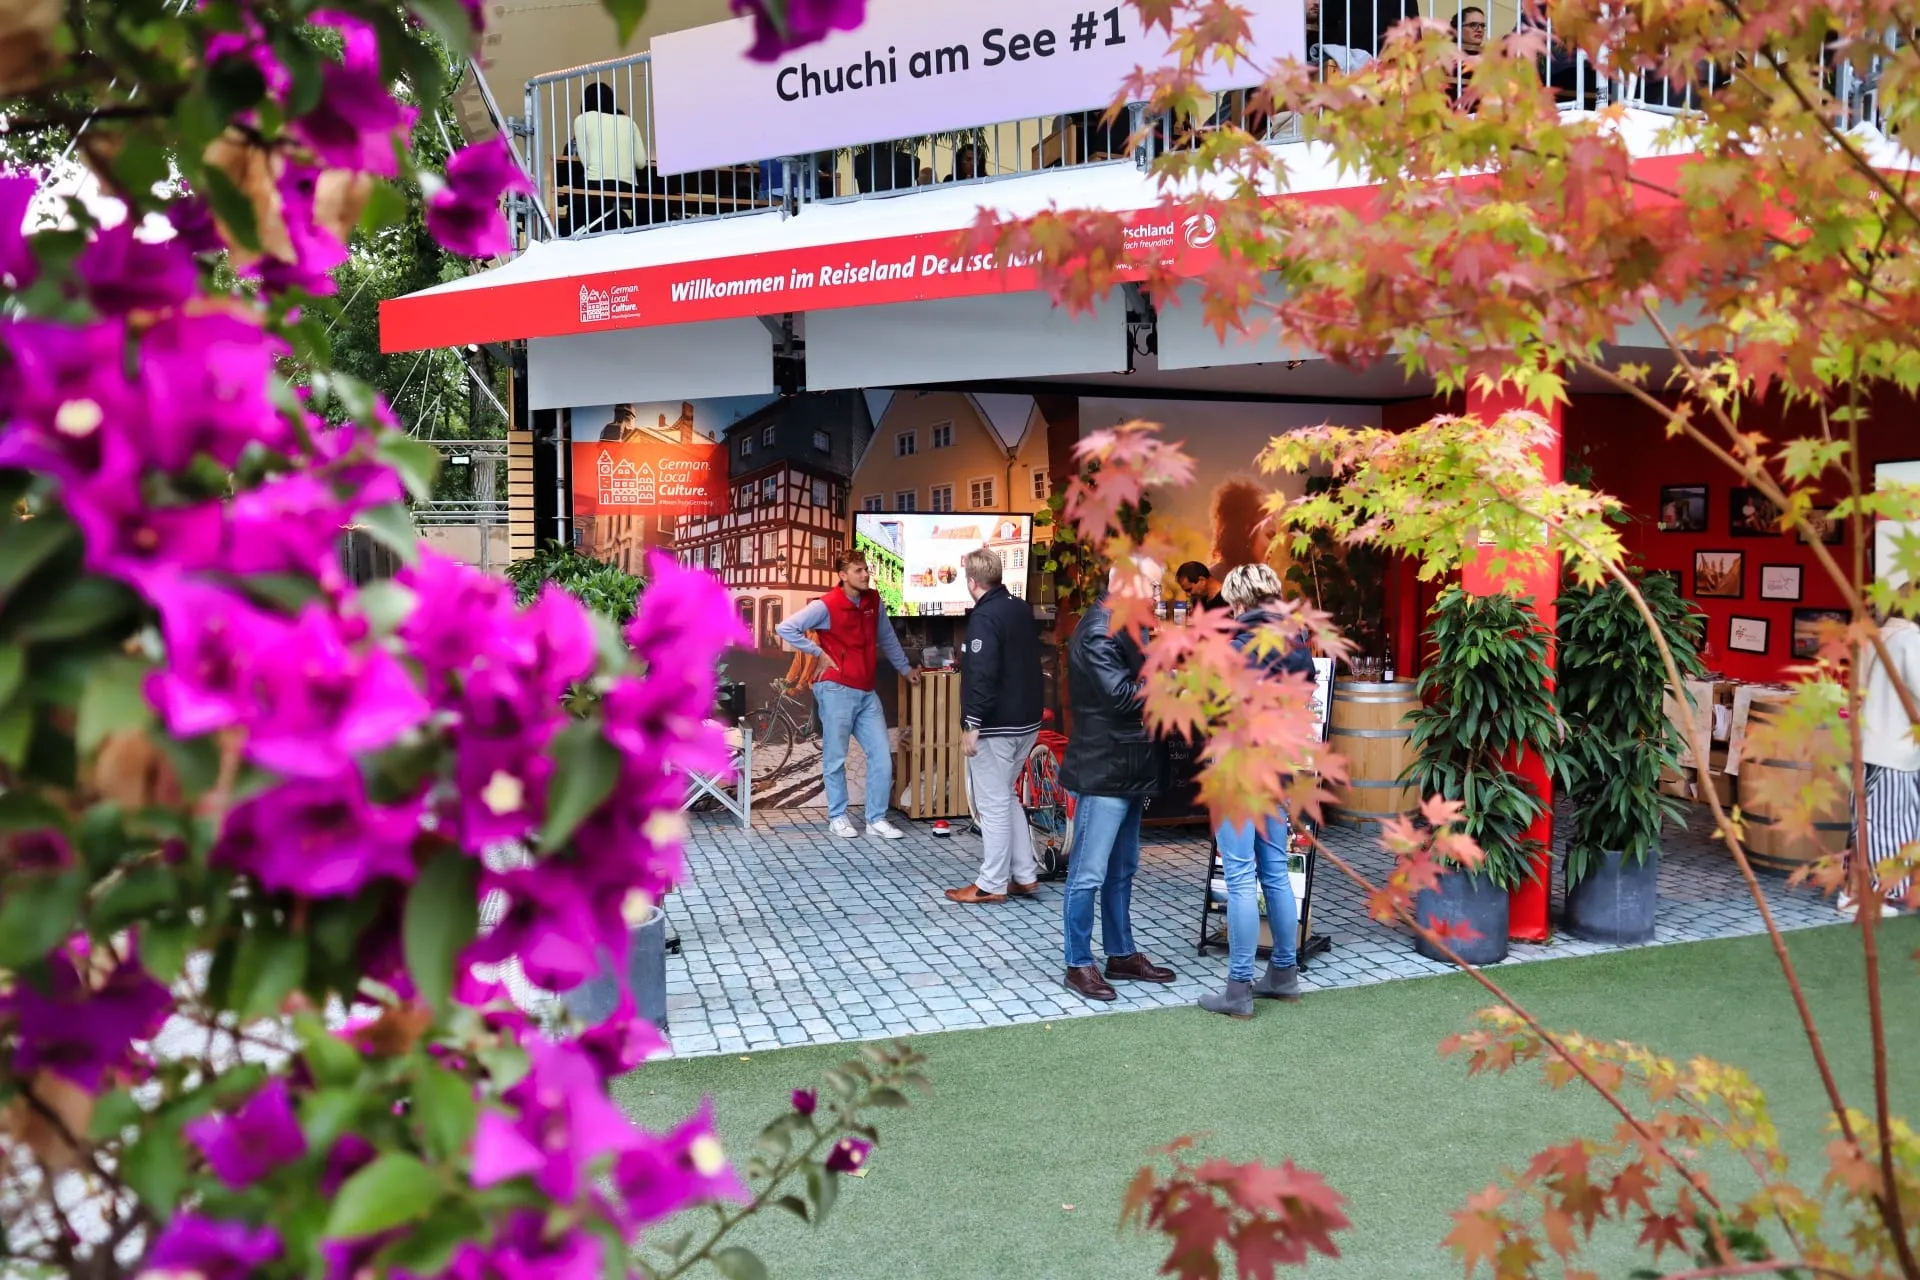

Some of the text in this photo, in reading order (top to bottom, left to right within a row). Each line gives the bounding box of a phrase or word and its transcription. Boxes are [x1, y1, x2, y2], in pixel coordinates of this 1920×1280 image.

[776, 6, 1126, 102] Chuchi am See #1
[1122, 221, 1174, 238] tschland
[1139, 237, 1174, 248] freundlich
[671, 275, 785, 303] Willkommen
[789, 268, 814, 290] im
[819, 254, 916, 287] Reiseland
[610, 285, 639, 294] German.
[611, 303, 637, 312] Culture.
[658, 458, 711, 471] German.
[659, 471, 692, 483] Local.
[659, 484, 708, 496] Culture.
